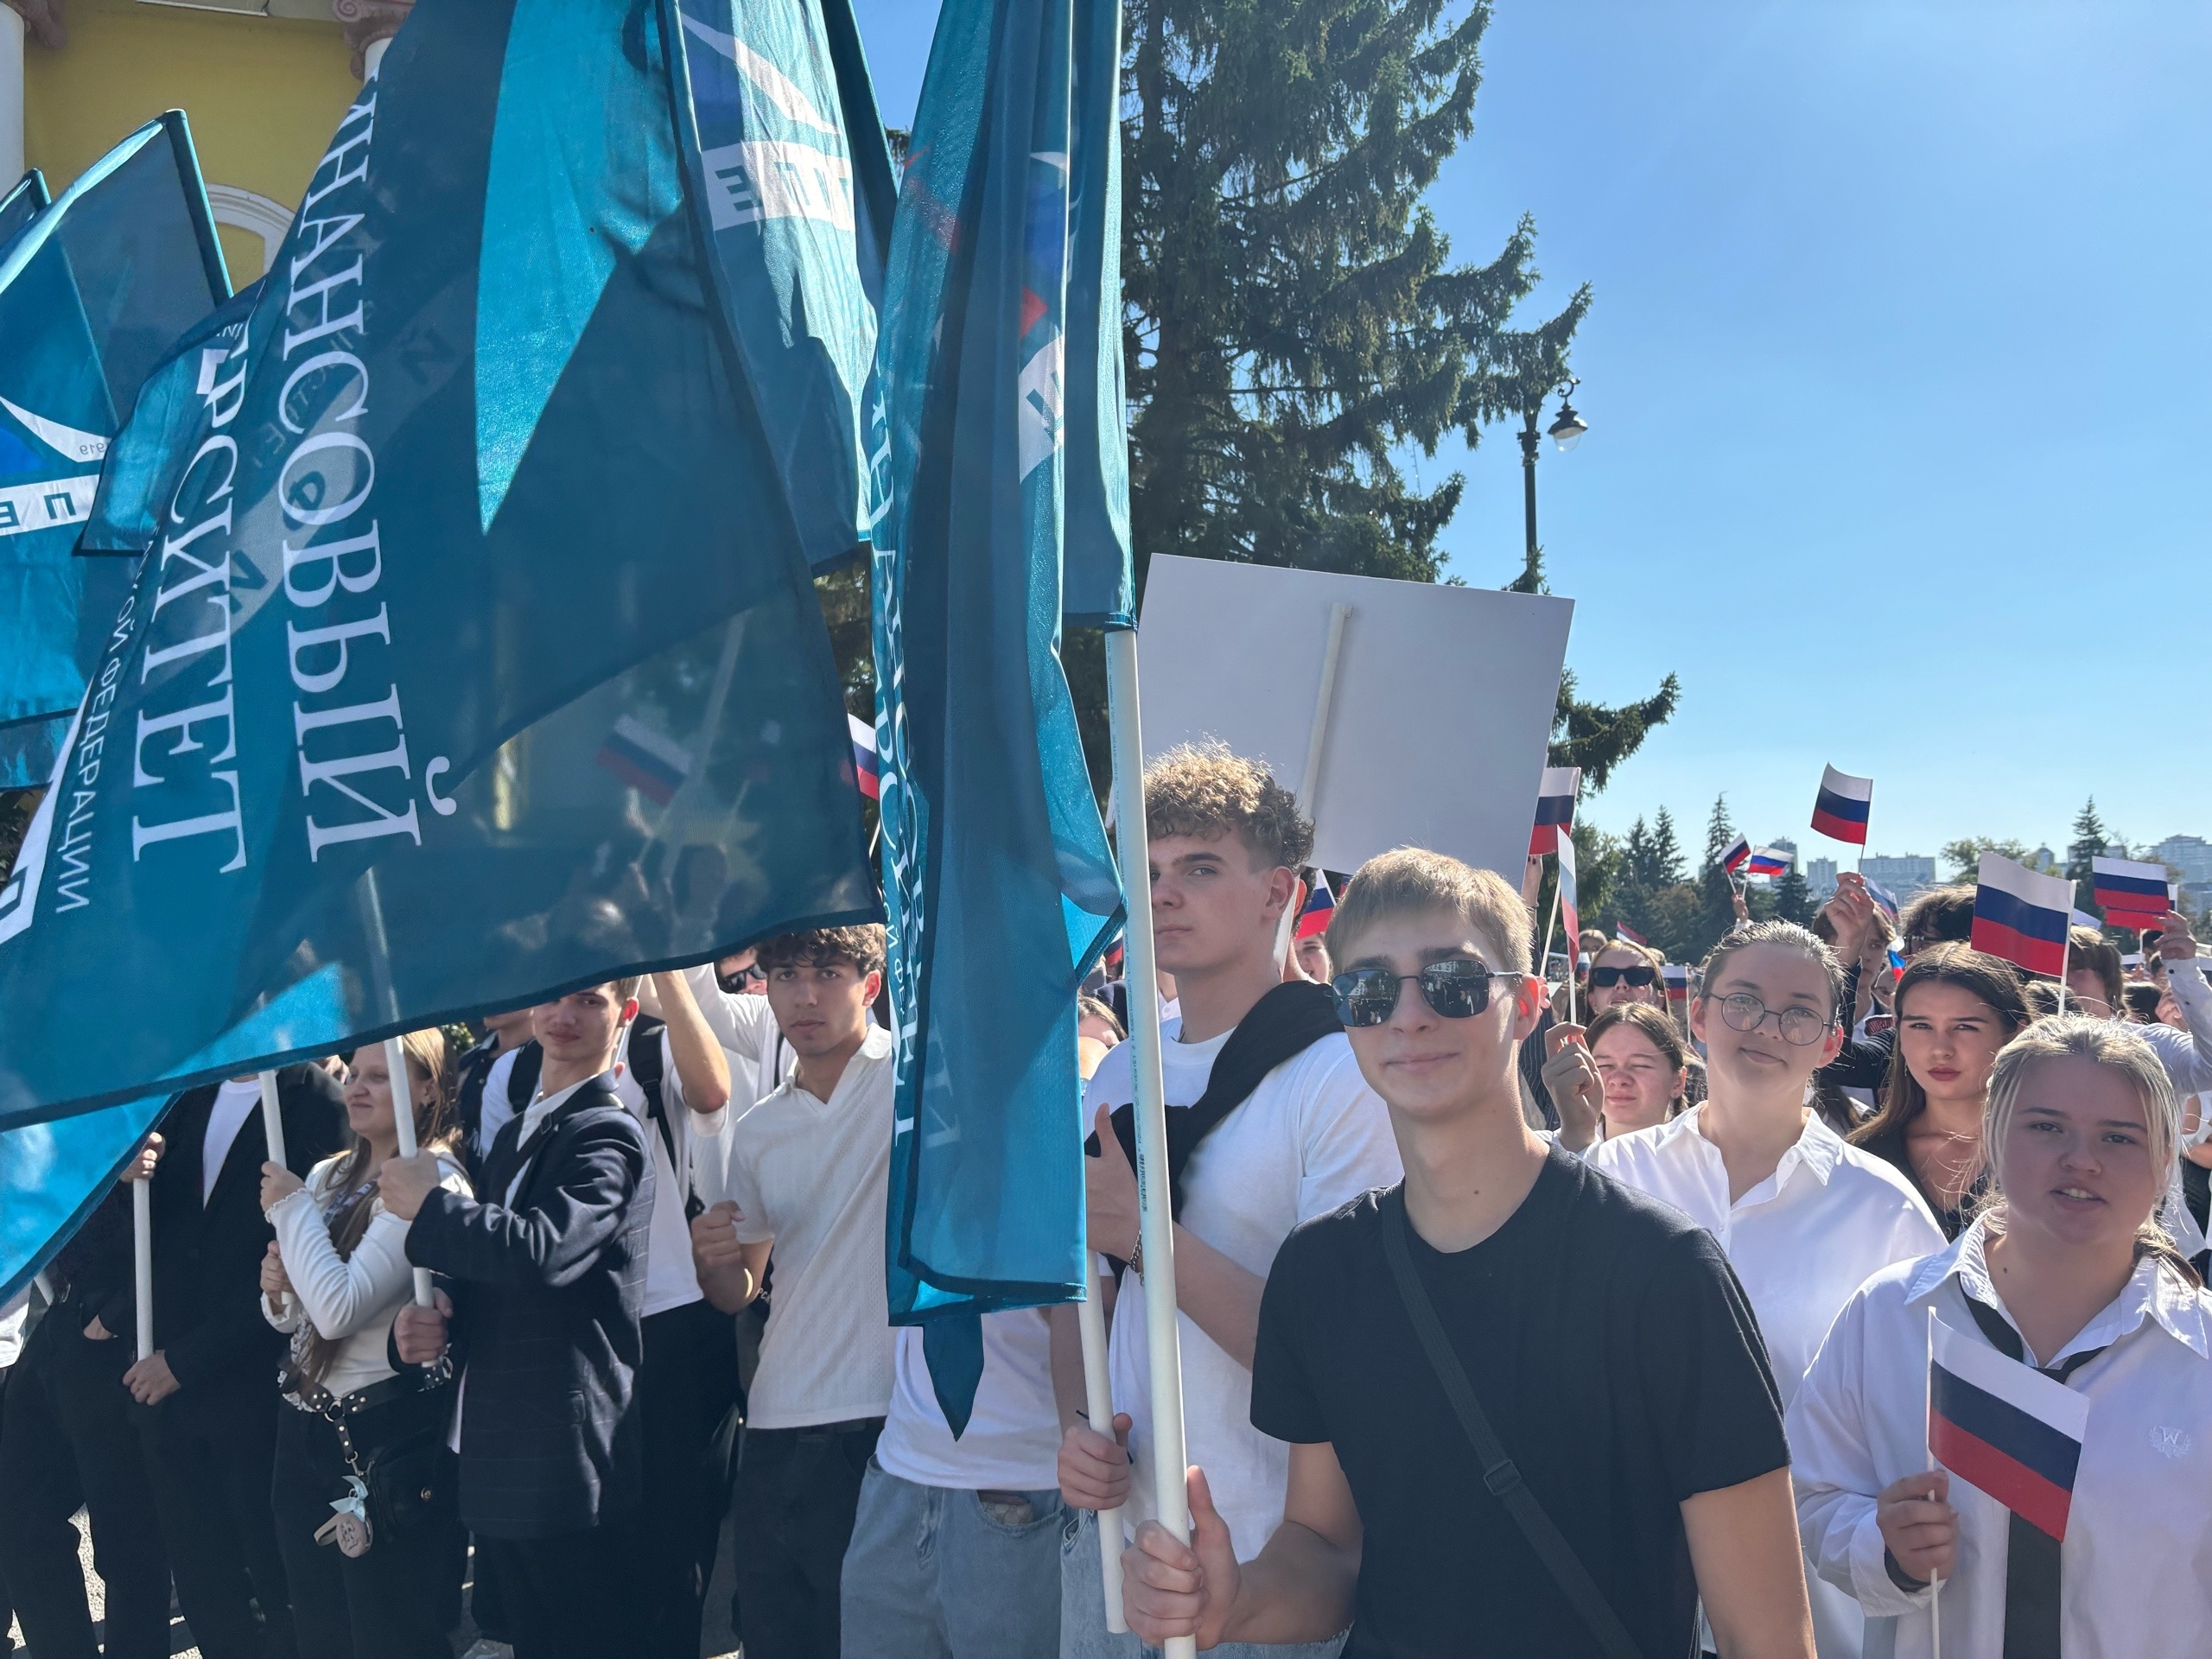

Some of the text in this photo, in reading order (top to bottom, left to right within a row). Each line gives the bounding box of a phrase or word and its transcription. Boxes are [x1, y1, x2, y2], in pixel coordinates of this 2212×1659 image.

[132, 285, 265, 874] РСИТЕТ
[277, 67, 457, 862] НАНСОВЫЙ
[56, 656, 122, 913] ФЕДЕРАЦИИ
